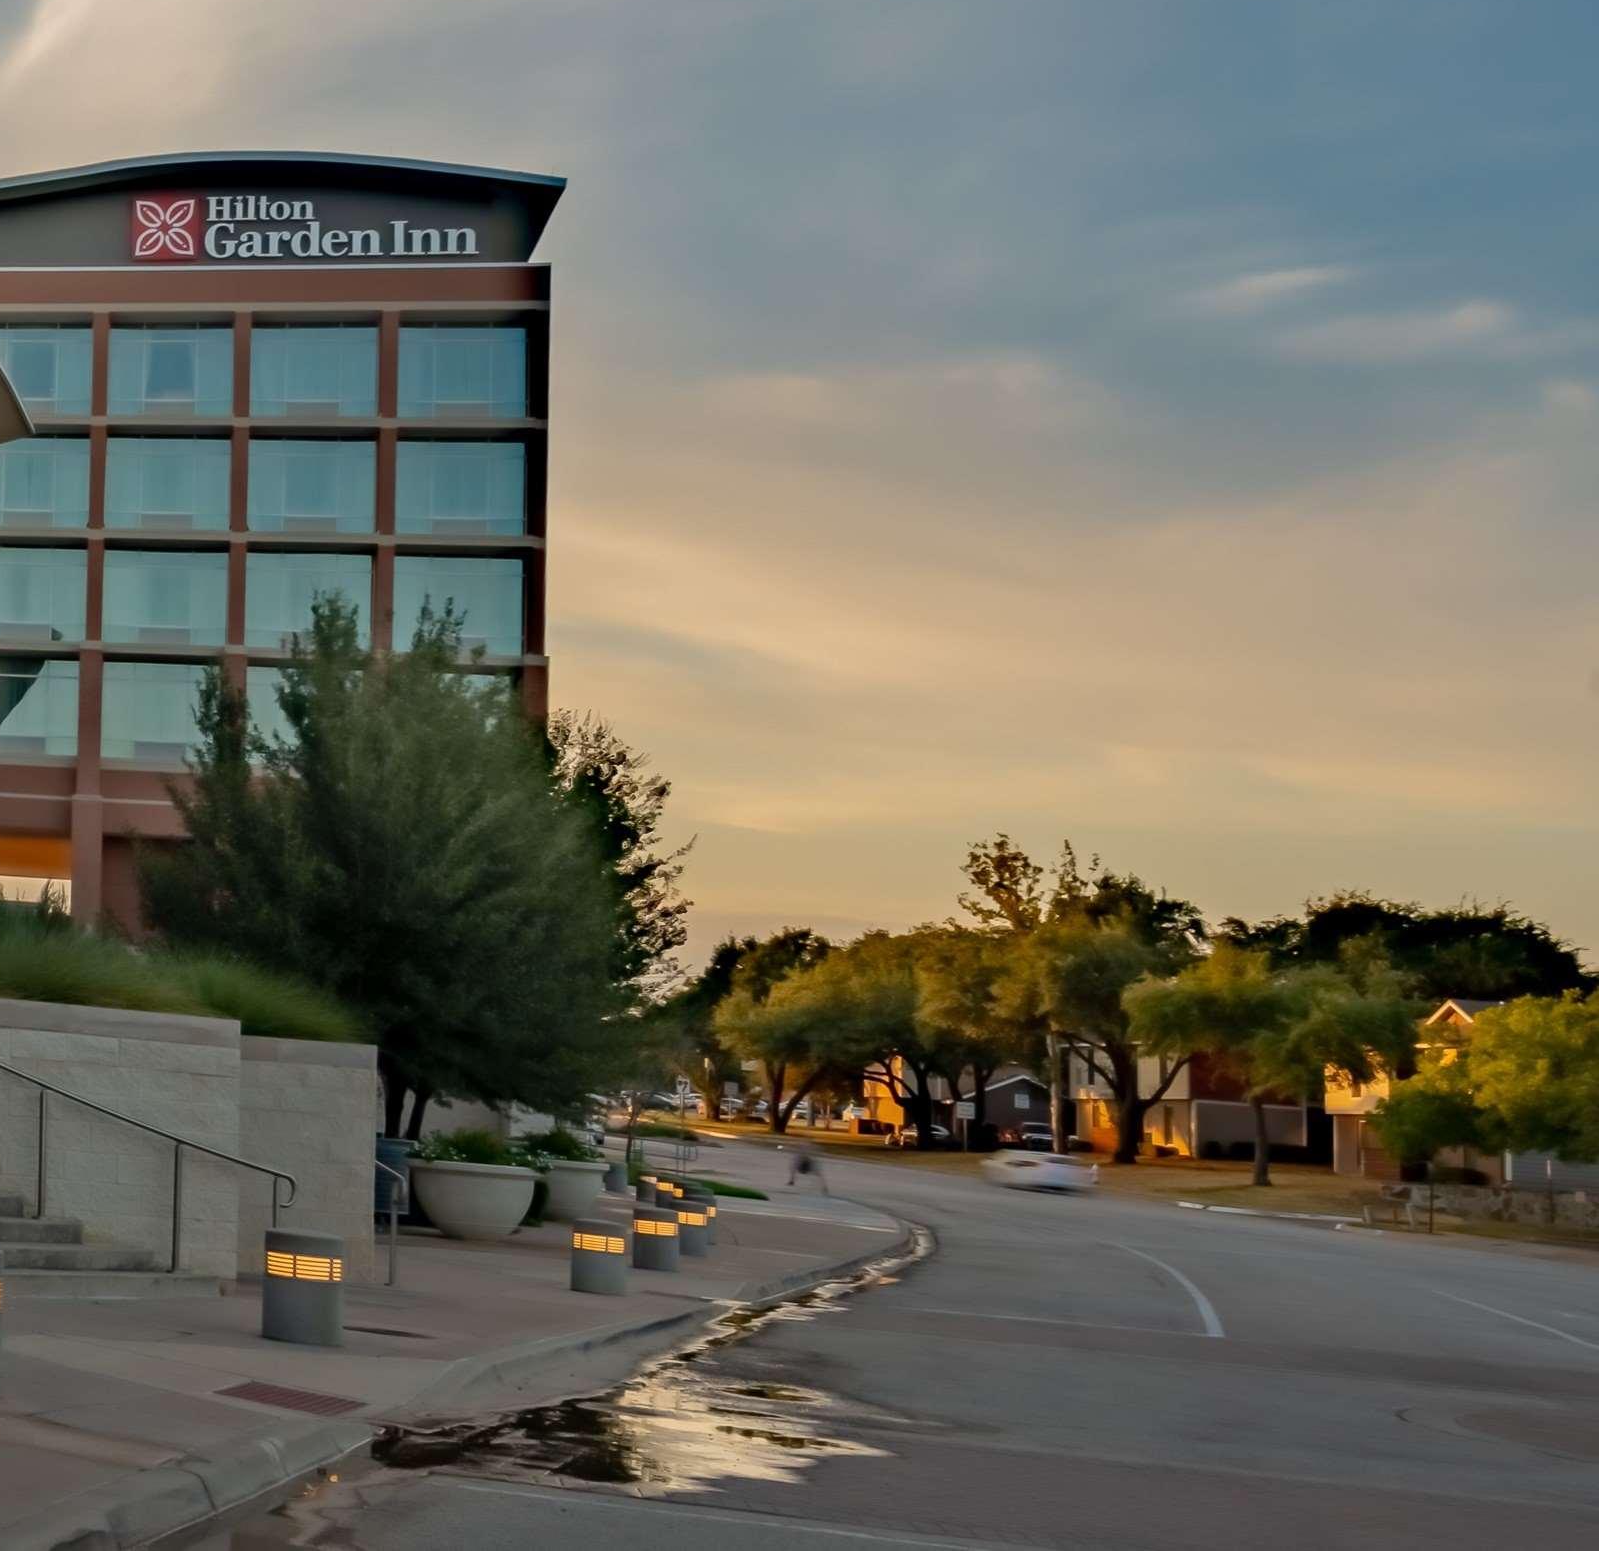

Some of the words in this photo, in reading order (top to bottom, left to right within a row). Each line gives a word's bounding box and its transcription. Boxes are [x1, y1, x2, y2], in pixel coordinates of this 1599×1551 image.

[206, 195, 315, 221] Hilton
[204, 221, 384, 259] Garden
[389, 220, 480, 256] Inn
